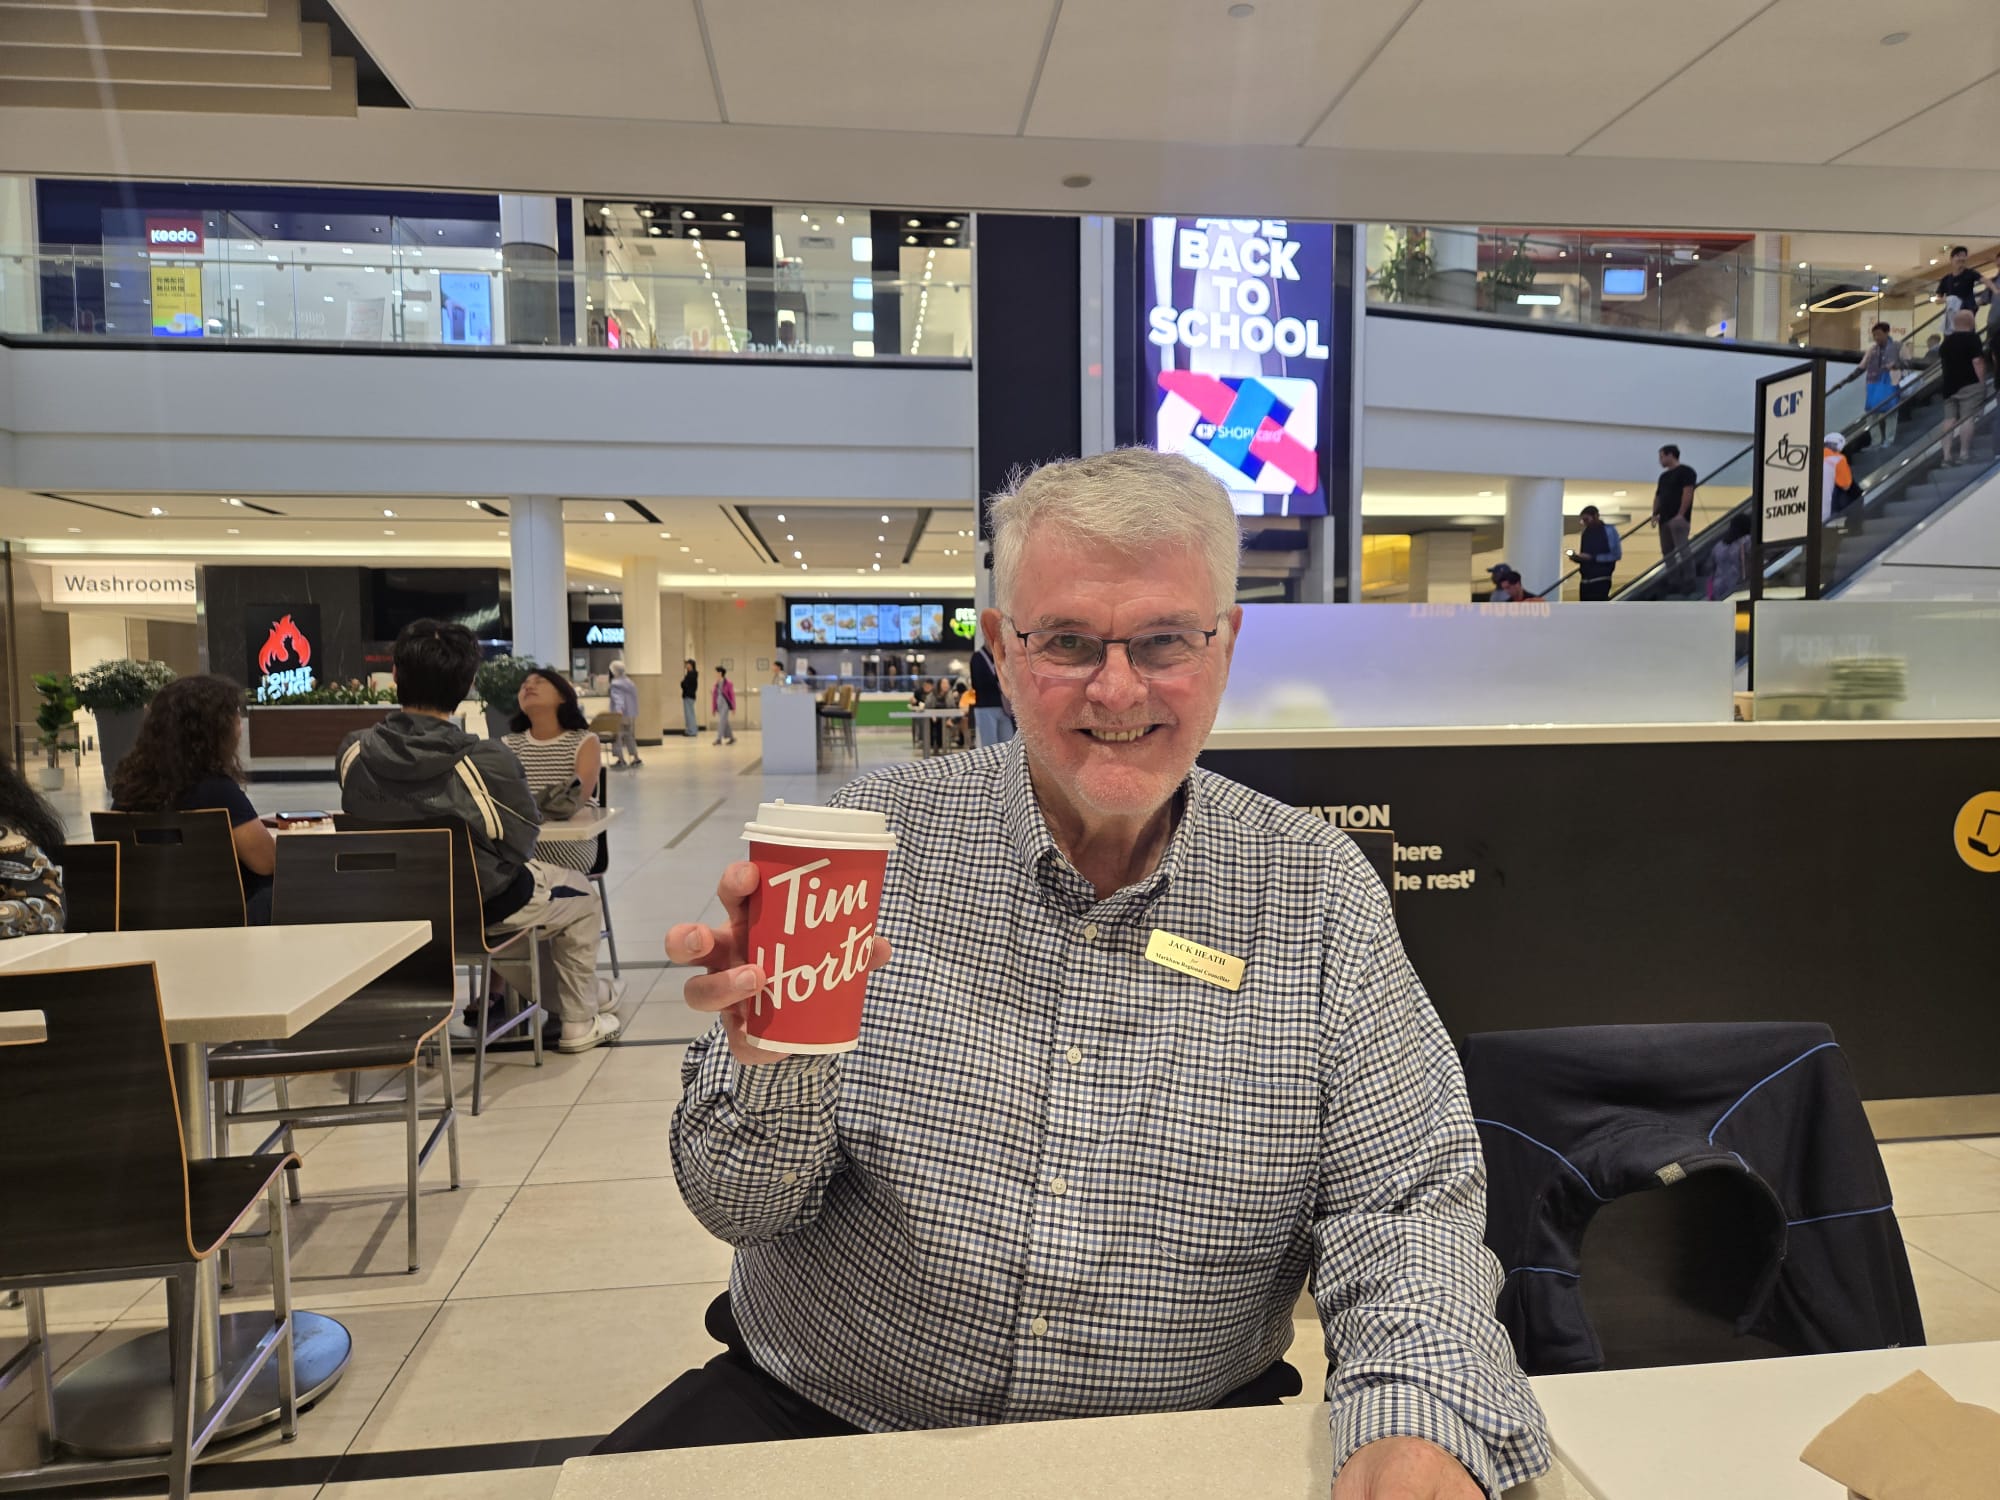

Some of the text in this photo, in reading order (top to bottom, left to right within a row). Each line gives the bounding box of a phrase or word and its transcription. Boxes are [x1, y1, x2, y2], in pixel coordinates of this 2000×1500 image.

[1179, 228, 1301, 281] BACK
[1212, 275, 1271, 316] TO
[1148, 304, 1329, 360] SCHOOL
[1773, 389, 1803, 418] CF
[1774, 485, 1799, 501] TRAY
[1765, 501, 1806, 519] STATION
[64, 574, 196, 593] Washrooms
[768, 857, 868, 936] Tim
[1168, 939, 1227, 966] JACK HEATH
[1180, 961, 1204, 975] Regional
